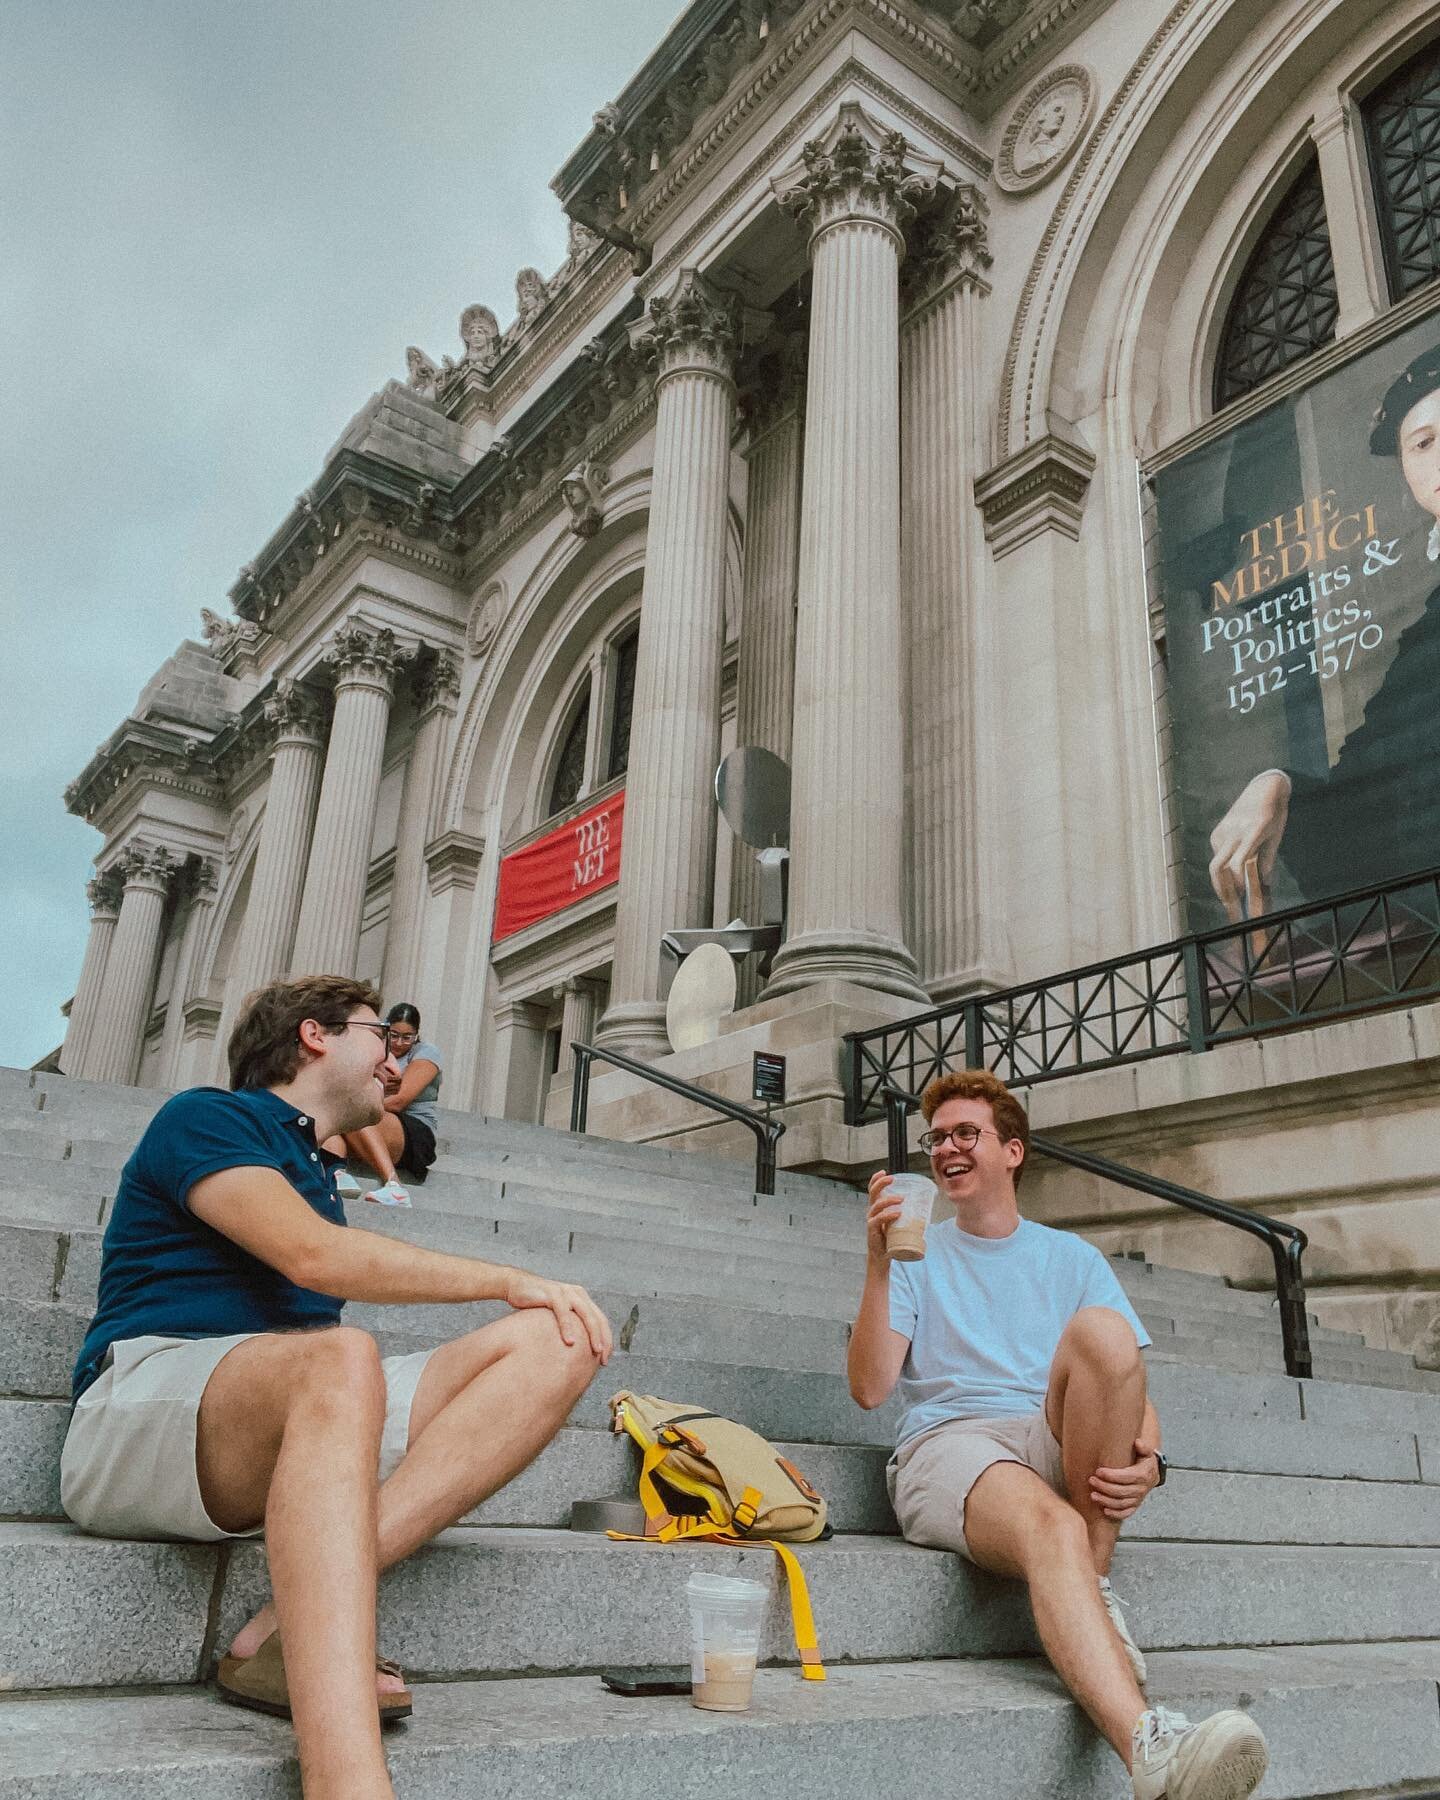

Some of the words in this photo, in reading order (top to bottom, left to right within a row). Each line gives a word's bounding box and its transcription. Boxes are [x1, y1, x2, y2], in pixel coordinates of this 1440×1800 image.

[1211, 504, 1377, 611] MEDICI
[1240, 489, 1339, 558] THE
[1201, 565, 1351, 653] Portraits
[1363, 539, 1402, 576] &
[1231, 600, 1372, 676] Politics,
[571, 844, 609, 892] MET
[575, 811, 610, 857] THE
